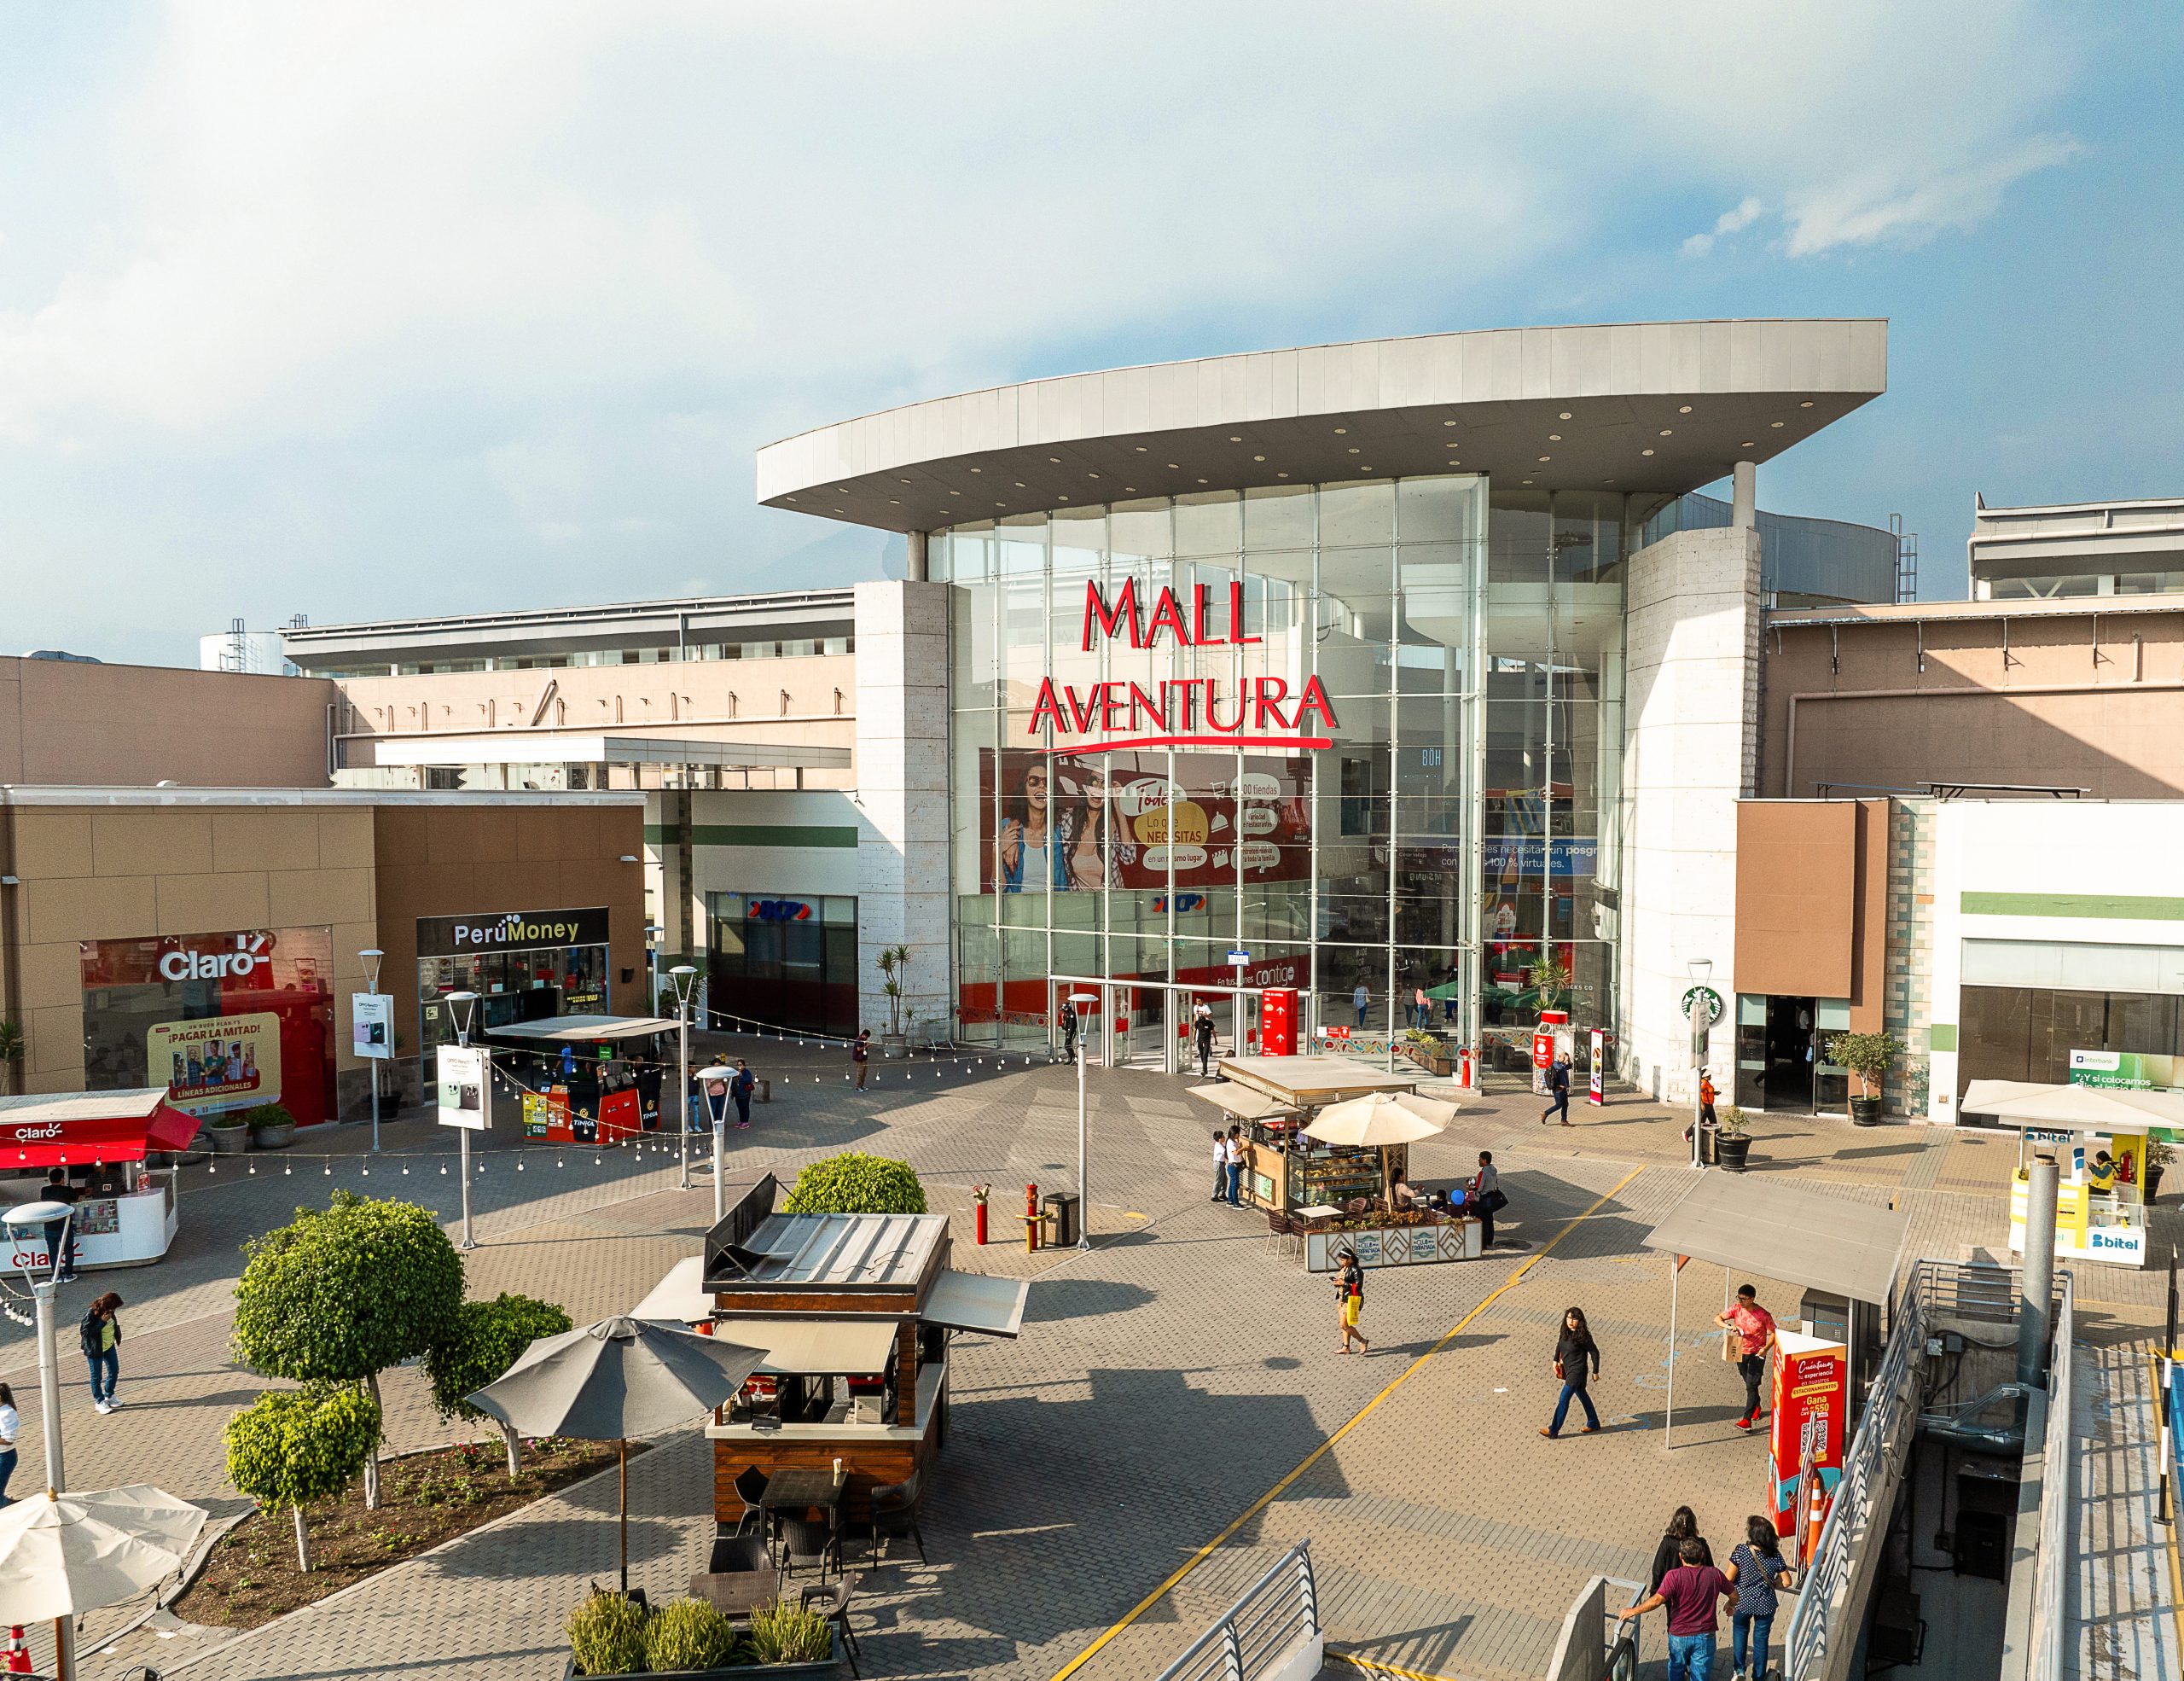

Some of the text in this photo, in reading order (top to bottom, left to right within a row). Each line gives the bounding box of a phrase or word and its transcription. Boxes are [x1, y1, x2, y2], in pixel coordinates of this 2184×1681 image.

[1082, 575, 1263, 652] MALL
[1027, 674, 1336, 735] AVENTURA
[1422, 749, 1441, 766] BÖH
[1253, 784, 1277, 795] tiendas
[1147, 816, 1178, 830] Lo qe
[1147, 831, 1202, 843] NECSITAS
[1188, 854, 1203, 864] lugar
[160, 944, 256, 981] Claro
[1256, 963, 1294, 986] contigo
[168, 1030, 206, 1044] ¡PAGAR
[209, 1028, 221, 1038] LA
[224, 1024, 260, 1037] MITAD!
[2101, 1076, 2152, 1086] colocamos
[177, 1081, 252, 1099] LÍNEAS ADICIONALES
[15, 1125, 57, 1139] Claro
[2104, 1236, 2139, 1250] bitel
[1798, 1360, 1833, 1374] Cuéntanos
[1804, 1370, 1833, 1379] experiencia
[1793, 1383, 1837, 1395] ESTACIONAMIENTOS
[1807, 1396, 1827, 1405] Gana
[1815, 1403, 1829, 1413] 550
